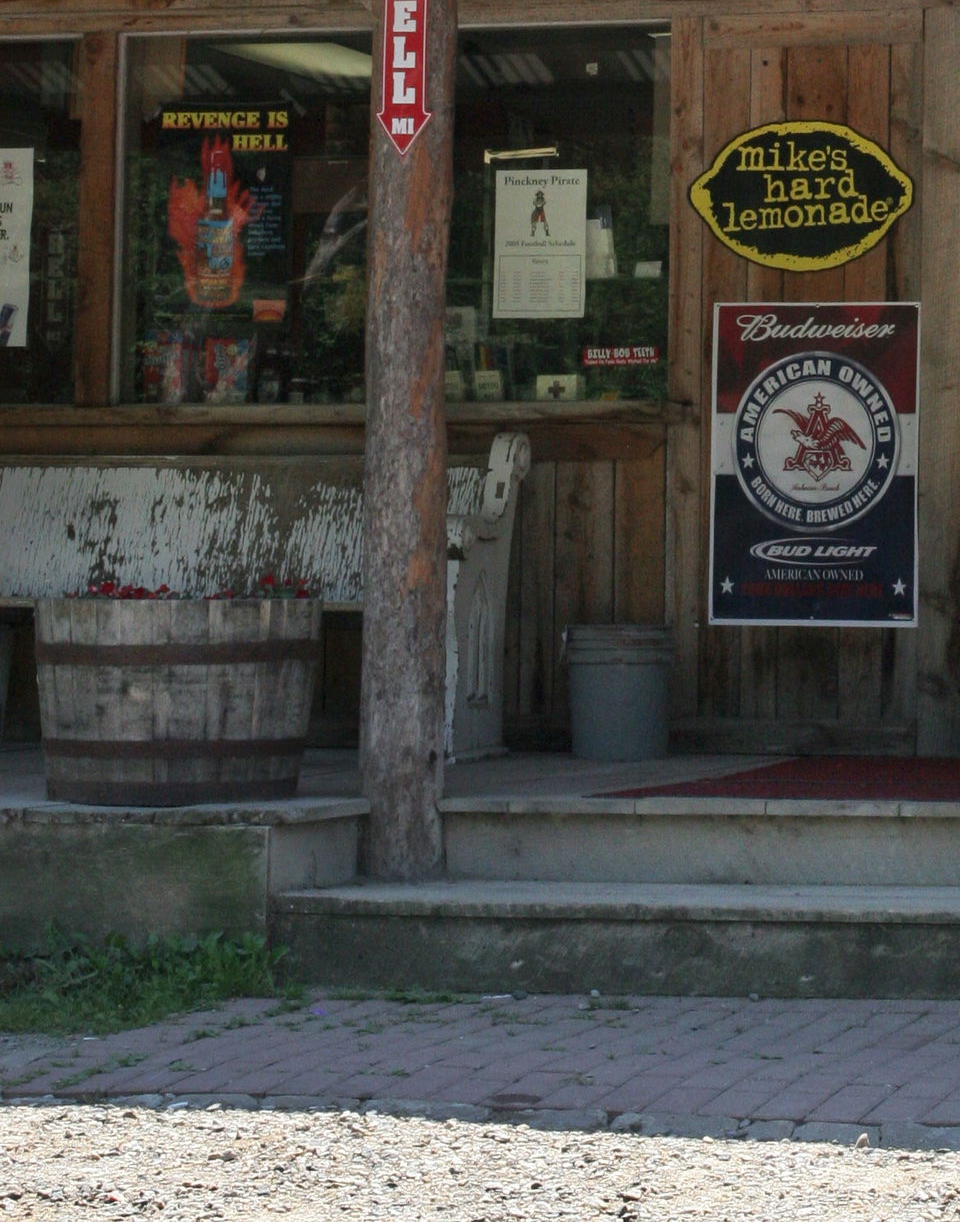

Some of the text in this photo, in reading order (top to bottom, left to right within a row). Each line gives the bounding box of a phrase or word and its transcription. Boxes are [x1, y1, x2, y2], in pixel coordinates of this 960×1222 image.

[162, 111, 289, 129] REVENGE IS
[391, 118, 415, 135] MI
[232, 134, 289, 151] HELL
[736, 141, 849, 171] mike's
[504, 175, 581, 189] Pinckney Pirate
[763, 169, 859, 203] hard
[722, 195, 890, 232] lemonade
[736, 313, 896, 342] Budweiser
[633, 346, 655, 358] TEETH
[740, 359, 892, 444] AMERICAN OWNED
[750, 475, 881, 524] BORN HERE. BREWED HERE.
[766, 544, 878, 558] BUD LIGHT
[764, 569, 864, 581] AMERICAN OWNED
